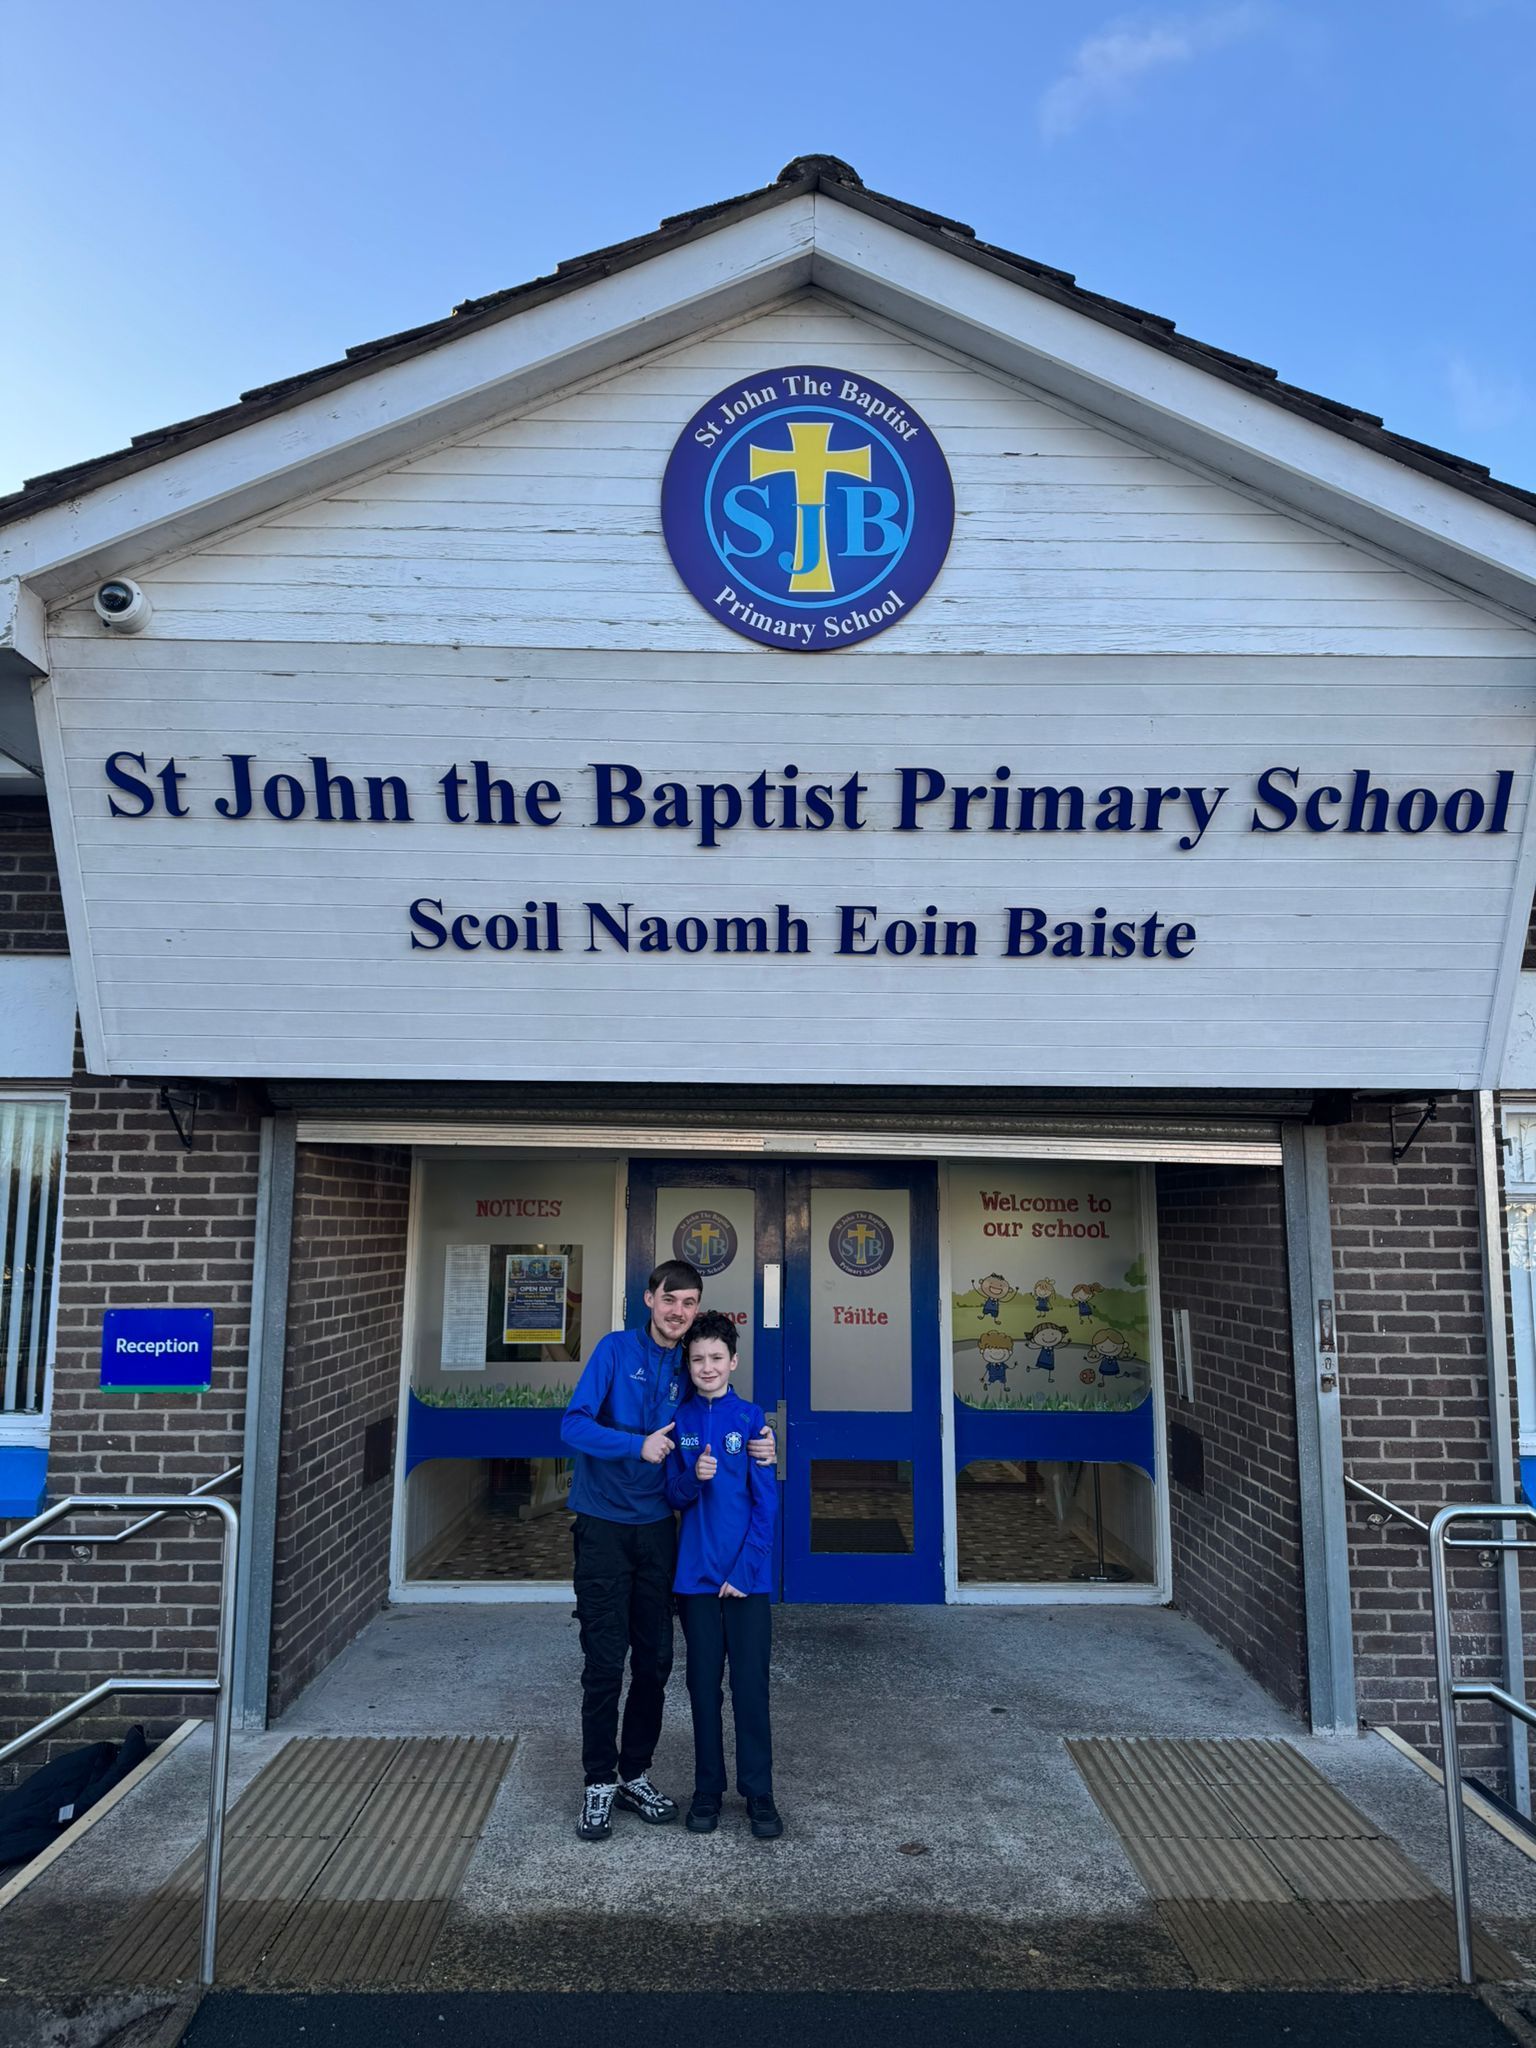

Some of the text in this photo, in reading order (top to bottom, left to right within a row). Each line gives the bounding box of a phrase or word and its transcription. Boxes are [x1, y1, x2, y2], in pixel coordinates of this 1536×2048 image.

[695, 375, 920, 449] St John The Baptist
[713, 585, 906, 644] Primary School
[103, 751, 1514, 850] St John the Baptist Primary School
[408, 898, 1197, 959] Scoil Naomh Eoin Baiste
[475, 1198, 563, 1218] NOTICES
[979, 1190, 1112, 1213] Welcome to
[983, 1218, 1110, 1239] our school
[833, 1305, 889, 1326] Fáilte
[115, 1337, 199, 1358] Reception
[680, 1437, 700, 1446] 2026
